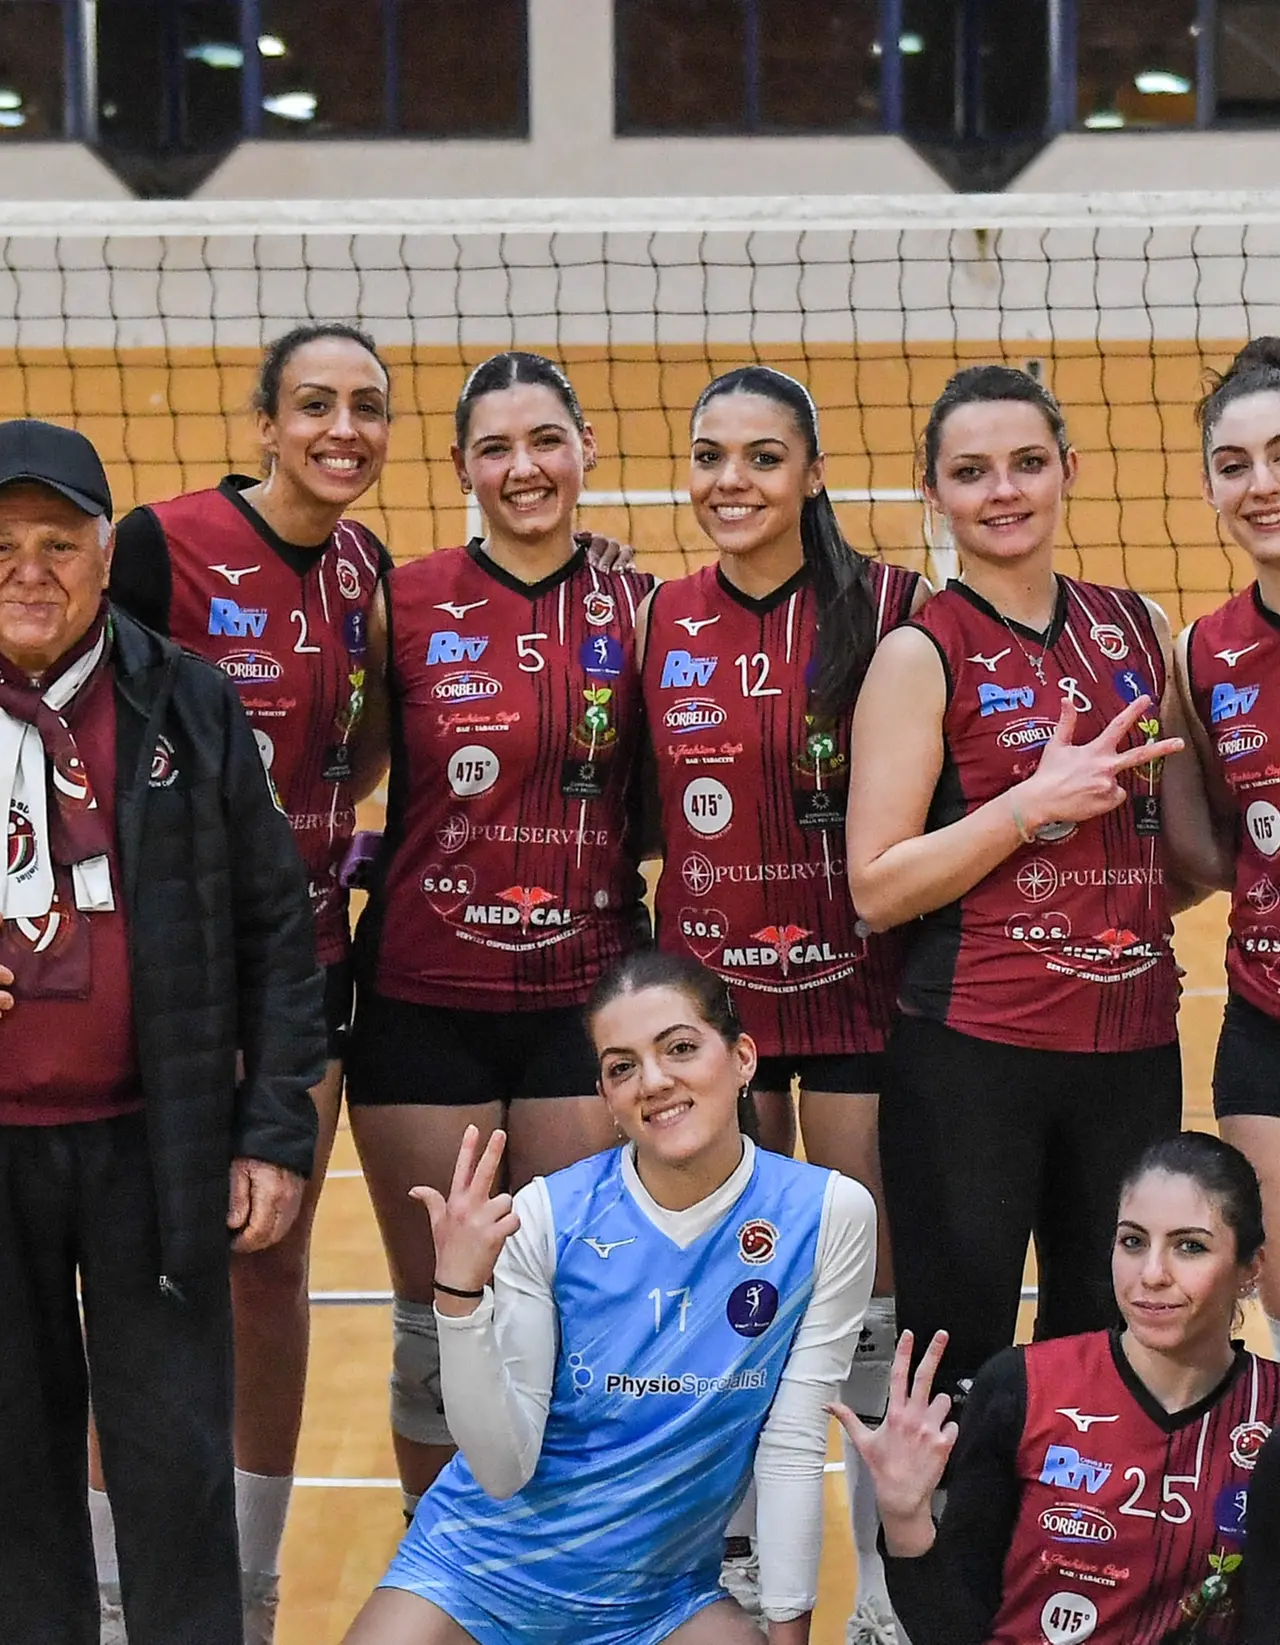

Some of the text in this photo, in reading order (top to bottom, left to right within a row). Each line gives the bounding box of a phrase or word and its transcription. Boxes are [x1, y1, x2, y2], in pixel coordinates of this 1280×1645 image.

[290, 609, 321, 653] 2
[515, 633, 548, 673] 5
[734, 652, 782, 697] 12
[435, 681, 499, 698] SORBELLO
[1058, 677, 1093, 712] 8
[666, 709, 723, 727] SORBELLO
[455, 760, 492, 782] 475°
[690, 793, 723, 817] 475°
[423, 878, 470, 894] S.O.S.
[715, 861, 847, 883] PULISERVIC
[682, 920, 725, 939] S.O.S.
[648, 1286, 692, 1333] 17
[1118, 1466, 1198, 1524] 25
[1042, 1513, 1112, 1542] SORBELLO
[1049, 1605, 1091, 1634] 475°
